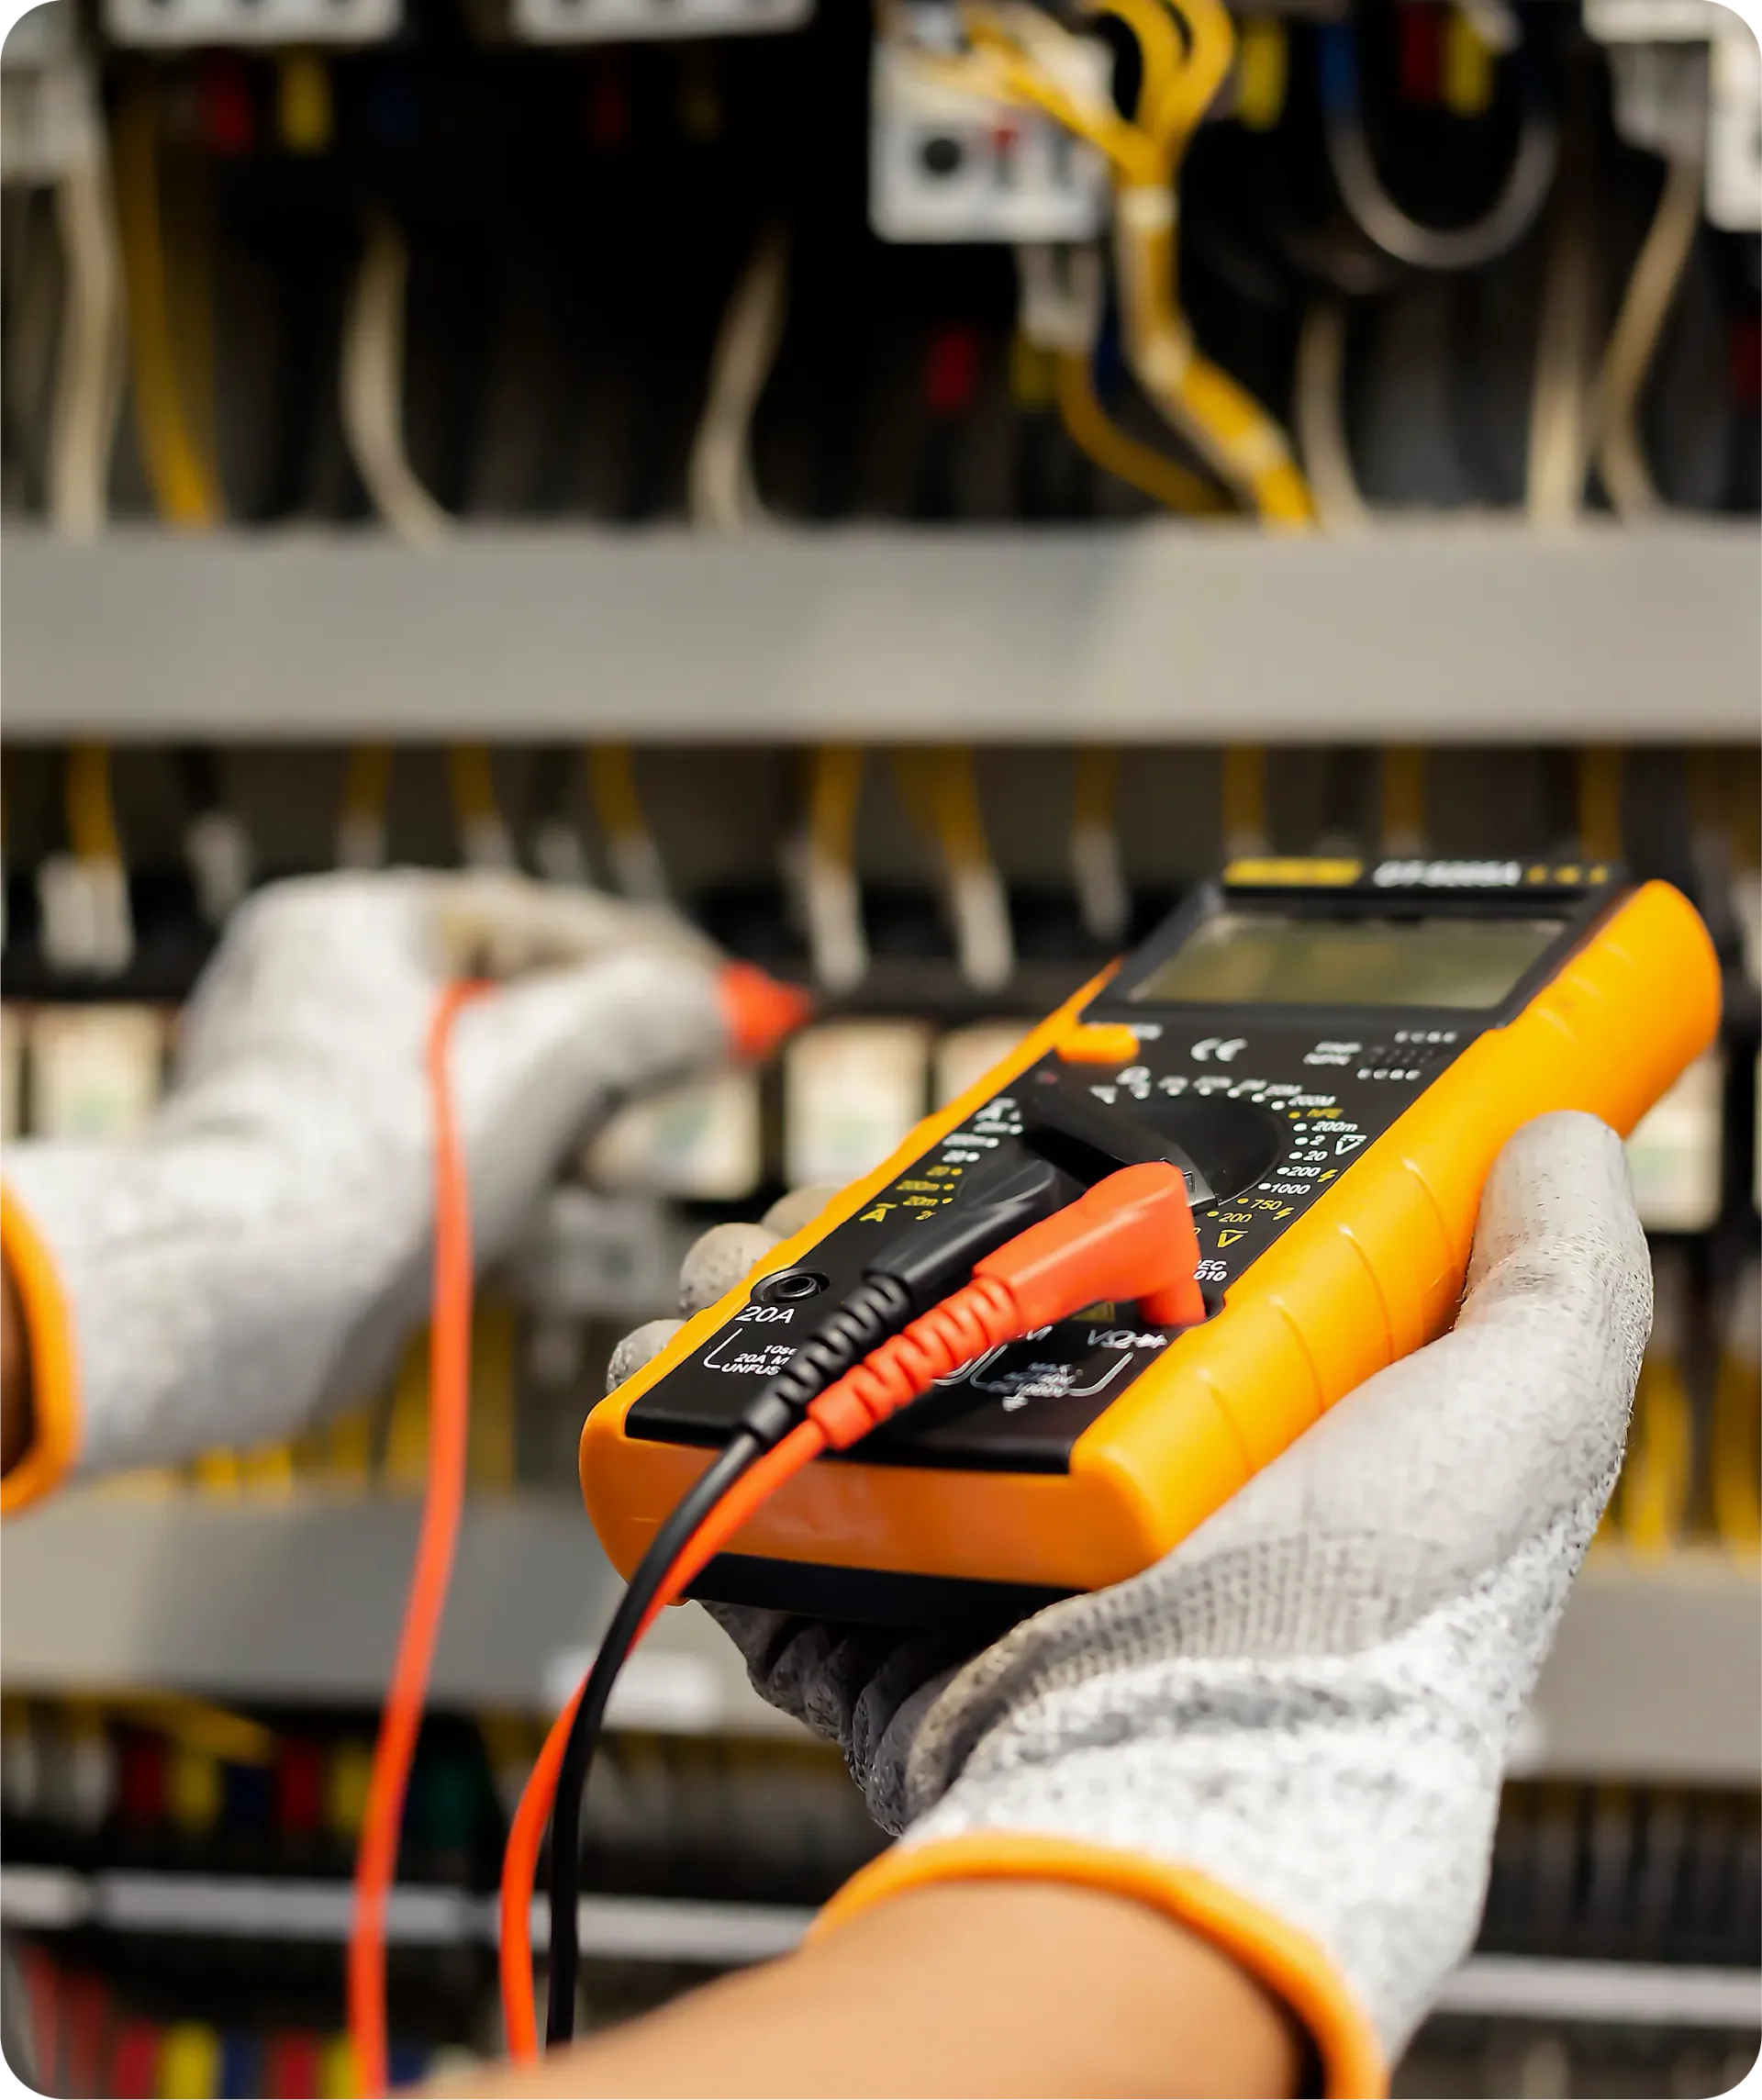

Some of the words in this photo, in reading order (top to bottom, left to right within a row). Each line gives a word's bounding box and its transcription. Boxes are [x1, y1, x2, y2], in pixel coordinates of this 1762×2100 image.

[1311, 1121, 1358, 1133] 200m
[1309, 1134, 1326, 1146] 2
[1302, 1150, 1328, 1162] 20
[1287, 1166, 1321, 1178] 200
[1270, 1183, 1310, 1195] 1000
[1250, 1199, 1283, 1211] 750
[1219, 1212, 1253, 1223] 200
[1197, 1260, 1228, 1271] EC
[734, 1305, 795, 1324] 20A
[734, 1353, 767, 1364] 20A
